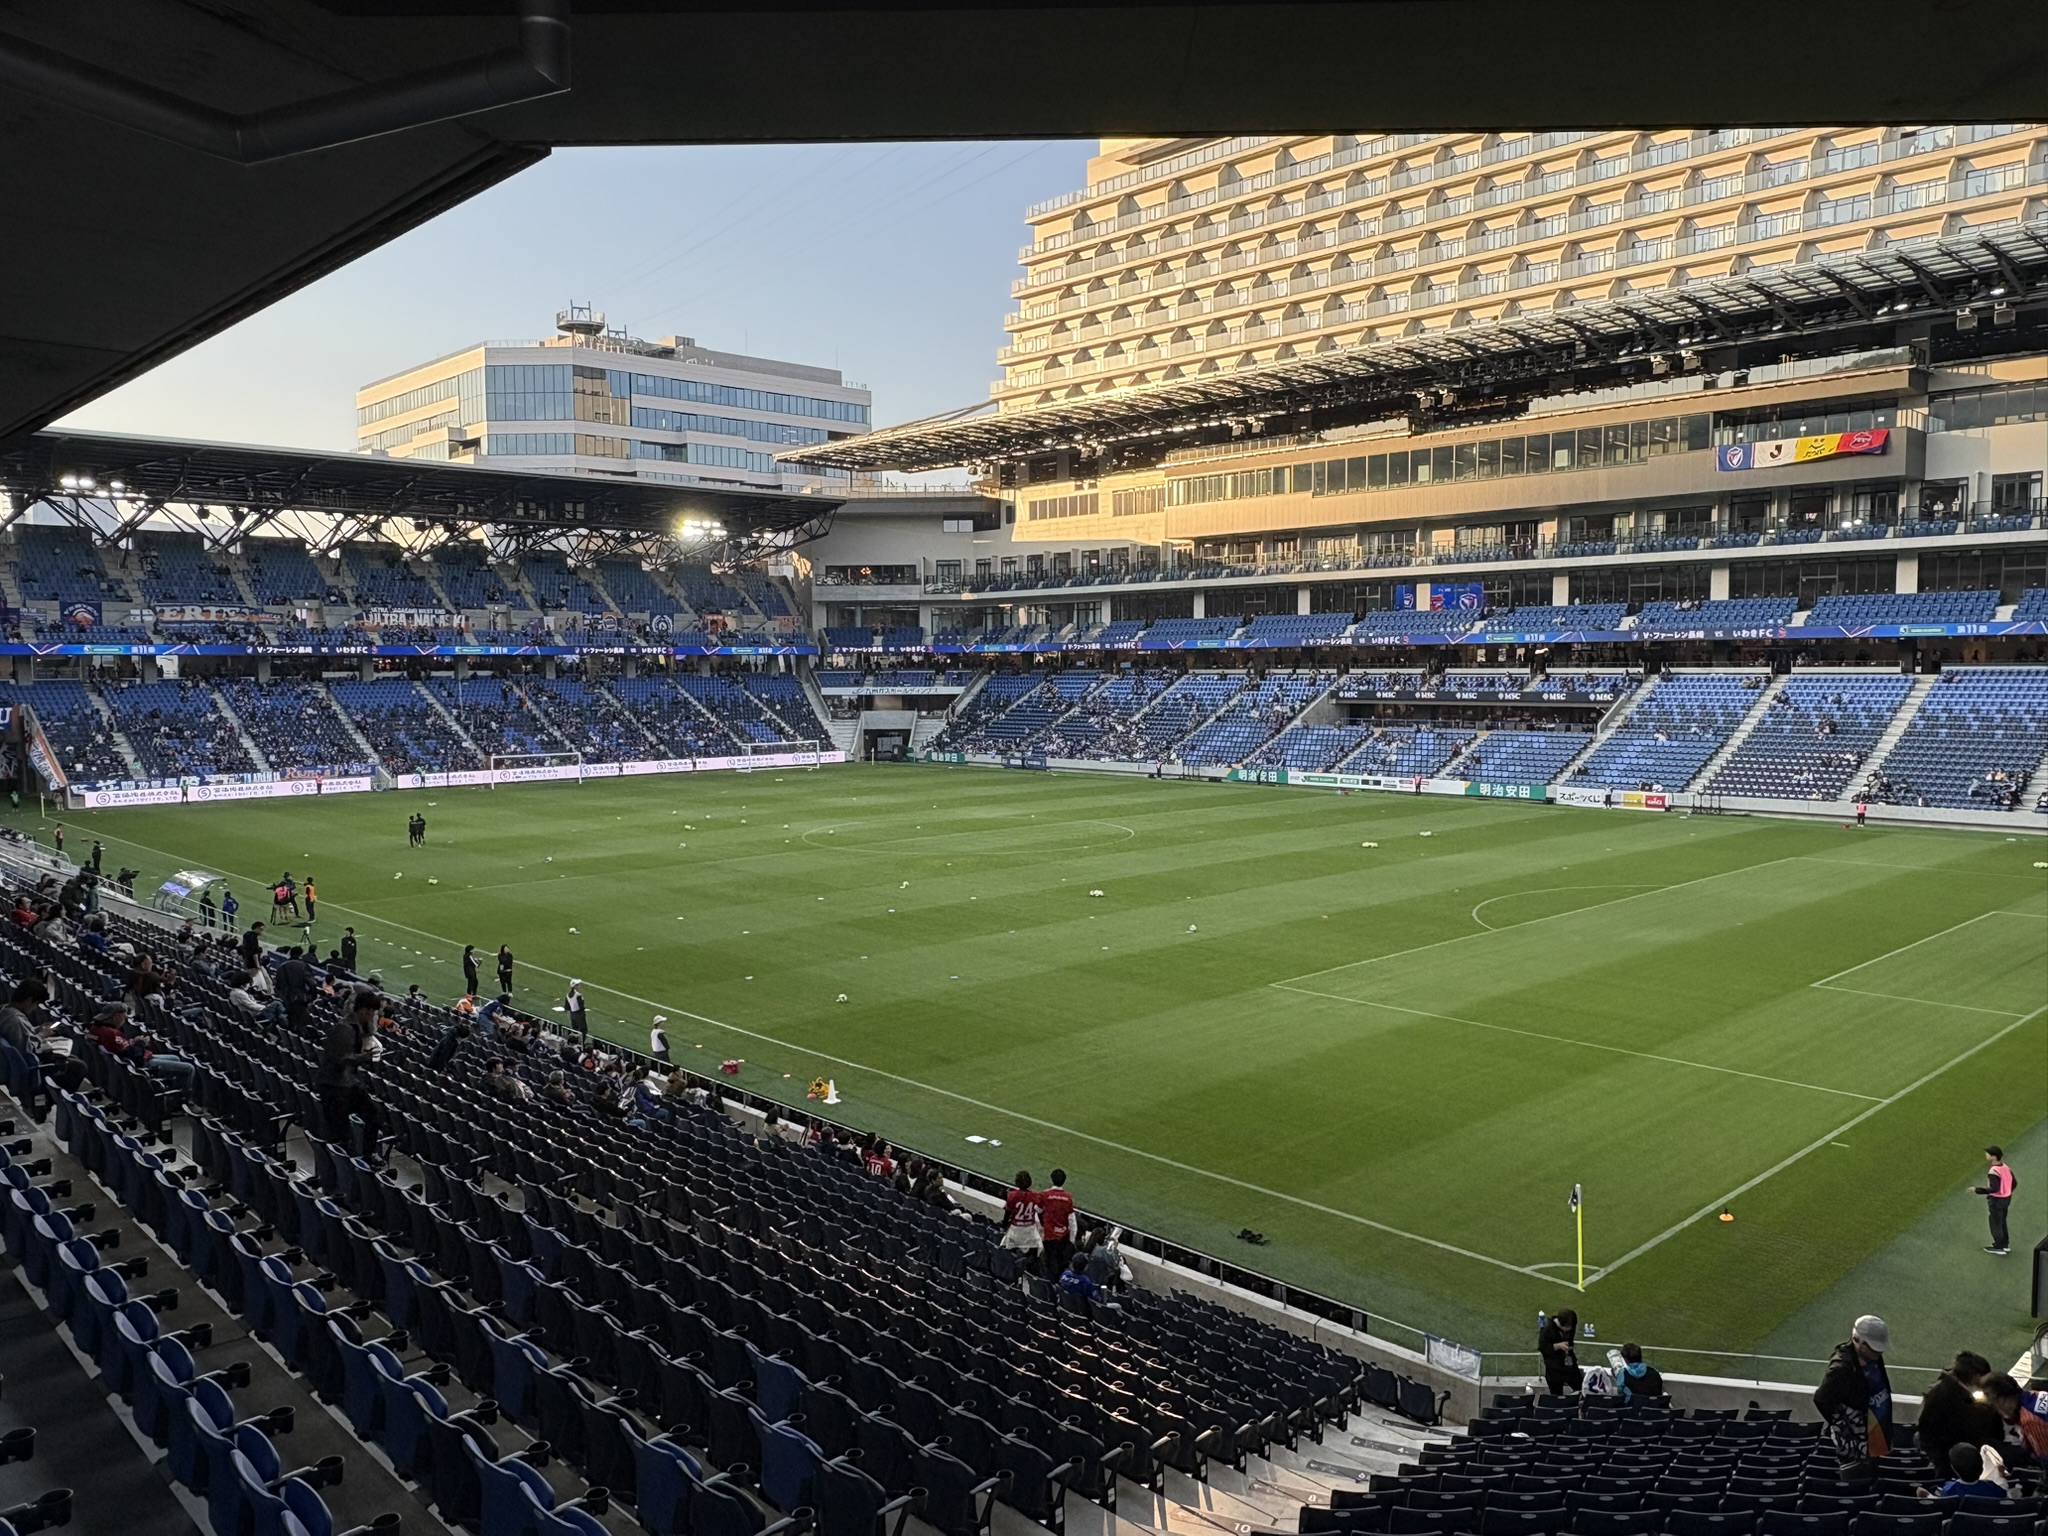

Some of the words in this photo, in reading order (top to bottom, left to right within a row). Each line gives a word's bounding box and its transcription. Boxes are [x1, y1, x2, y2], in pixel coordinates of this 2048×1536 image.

[1733, 628, 1773, 638] いわきFC
[1549, 692, 1566, 700] MSC
[1479, 783, 1530, 798] 明治安田
[1560, 792, 1601, 804] スポーツくじ
[1014, 1201, 1034, 1220] 24
